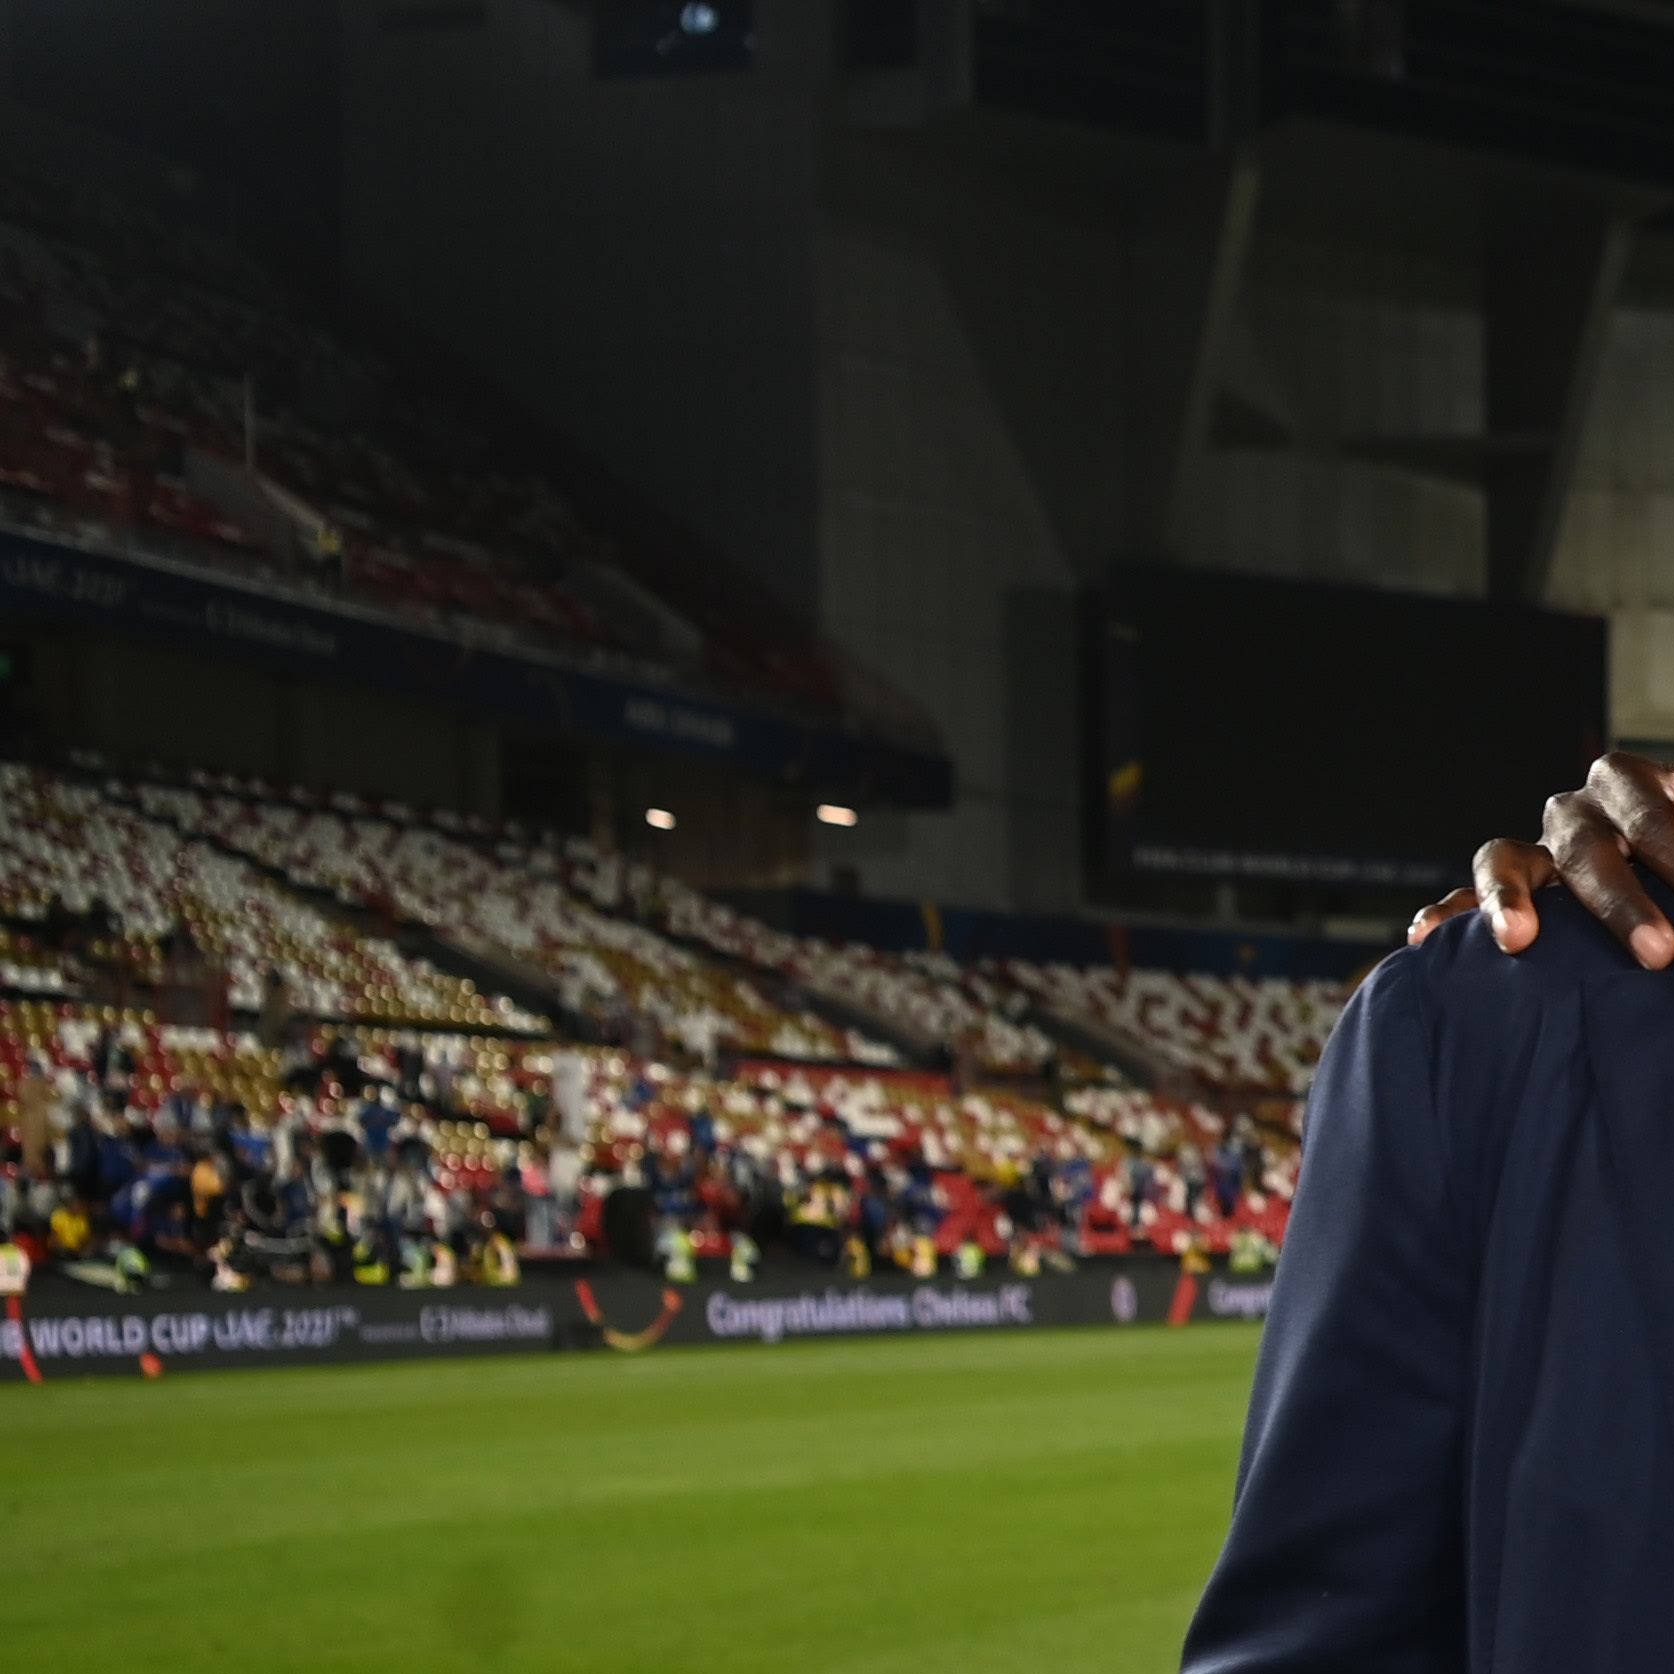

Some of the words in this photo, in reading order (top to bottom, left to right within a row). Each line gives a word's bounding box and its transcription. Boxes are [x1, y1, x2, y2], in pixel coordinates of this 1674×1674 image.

[29, 1315, 148, 1357] WORLD
[151, 1312, 212, 1354] CUP
[707, 1291, 910, 1343] Congratulations
